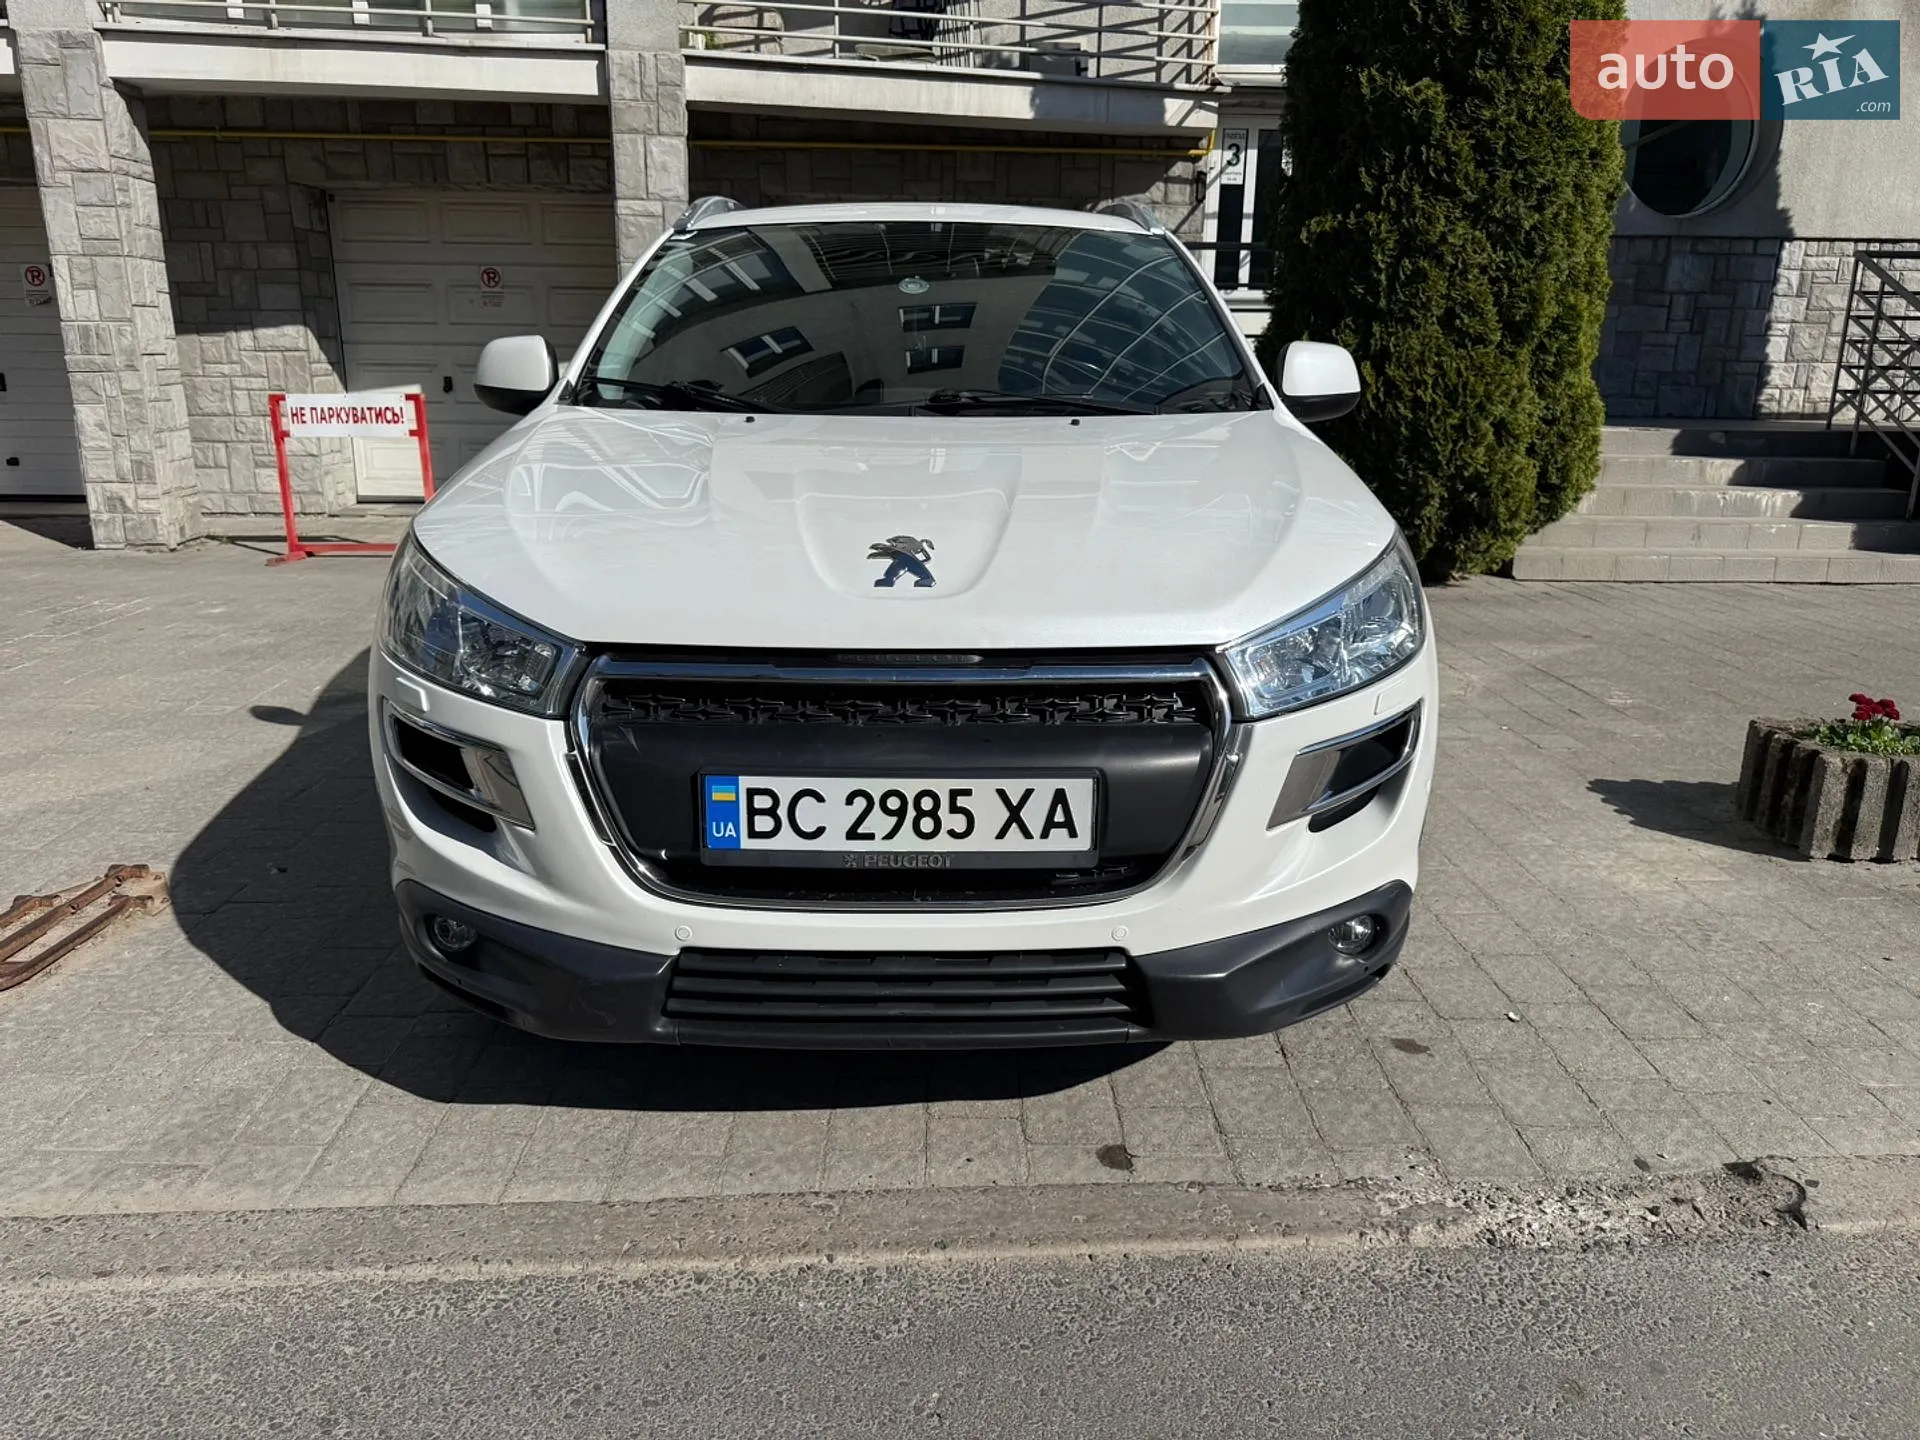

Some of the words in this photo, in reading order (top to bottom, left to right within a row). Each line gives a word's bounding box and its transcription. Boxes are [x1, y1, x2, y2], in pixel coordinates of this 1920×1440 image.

[1227, 143, 1240, 167] 3
[290, 406, 307, 424] НЕ
[310, 406, 404, 424] ПАРКУВАТИСЬ!
[745, 787, 826, 840] BC
[844, 788, 975, 841] 2985
[994, 787, 1079, 839] XA
[712, 821, 736, 838] UA
[864, 853, 954, 868] PEUGEOT
